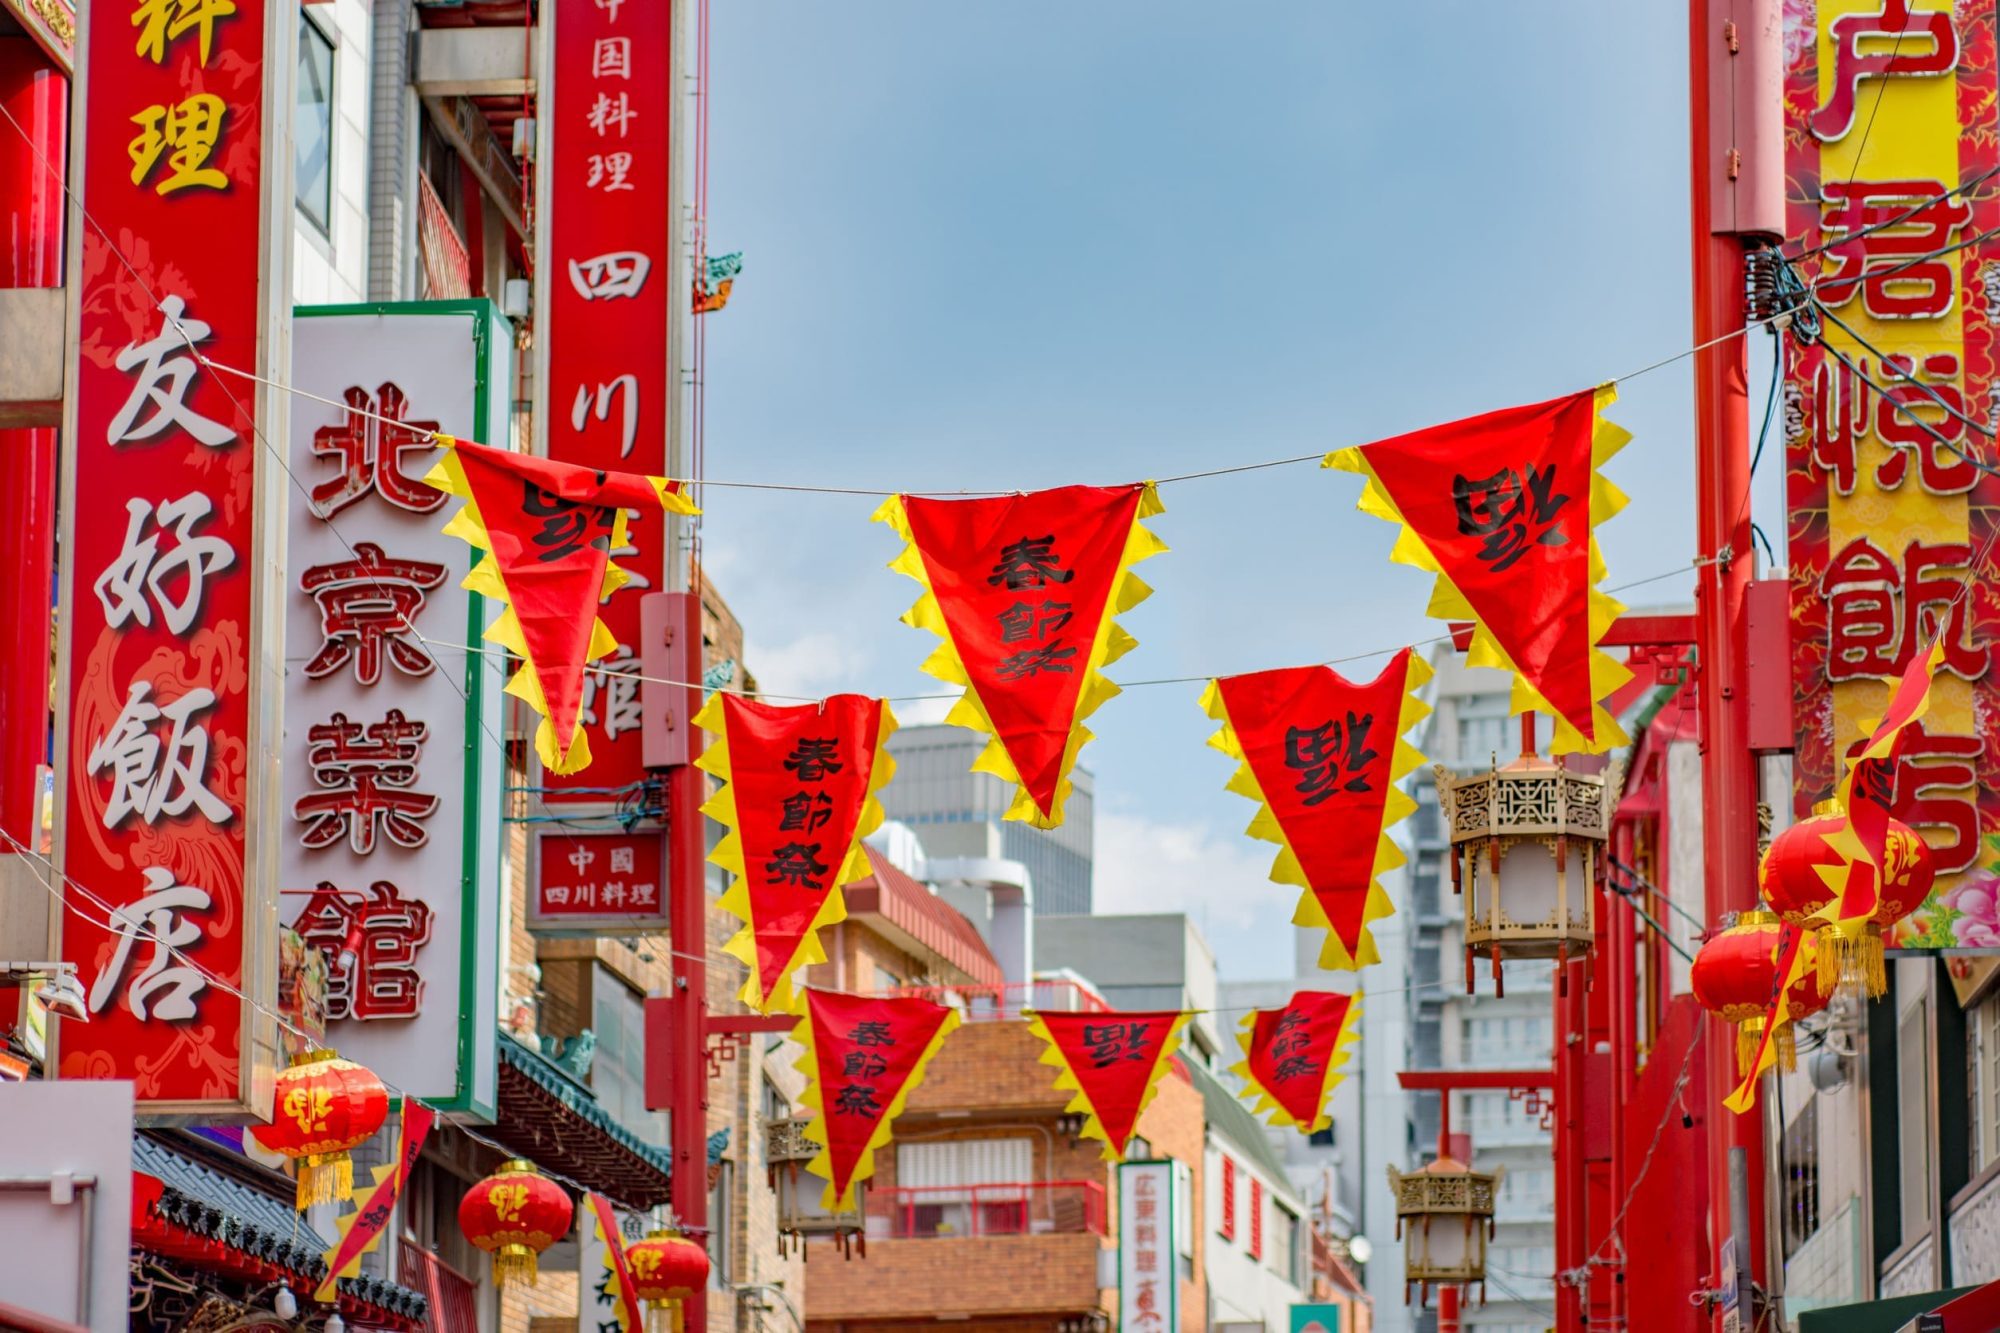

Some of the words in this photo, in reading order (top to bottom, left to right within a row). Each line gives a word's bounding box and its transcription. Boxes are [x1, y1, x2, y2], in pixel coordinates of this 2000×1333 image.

[128, 0, 237, 196] 料理
[87, 294, 237, 1022] 友好飯店
[987, 533, 1078, 683] 春節祭
[290, 381, 449, 1021] 北京菜館
[765, 737, 844, 890] 春節祭
[545, 881, 657, 908] 四川料理
[835, 1021, 895, 1119] 春節祭
